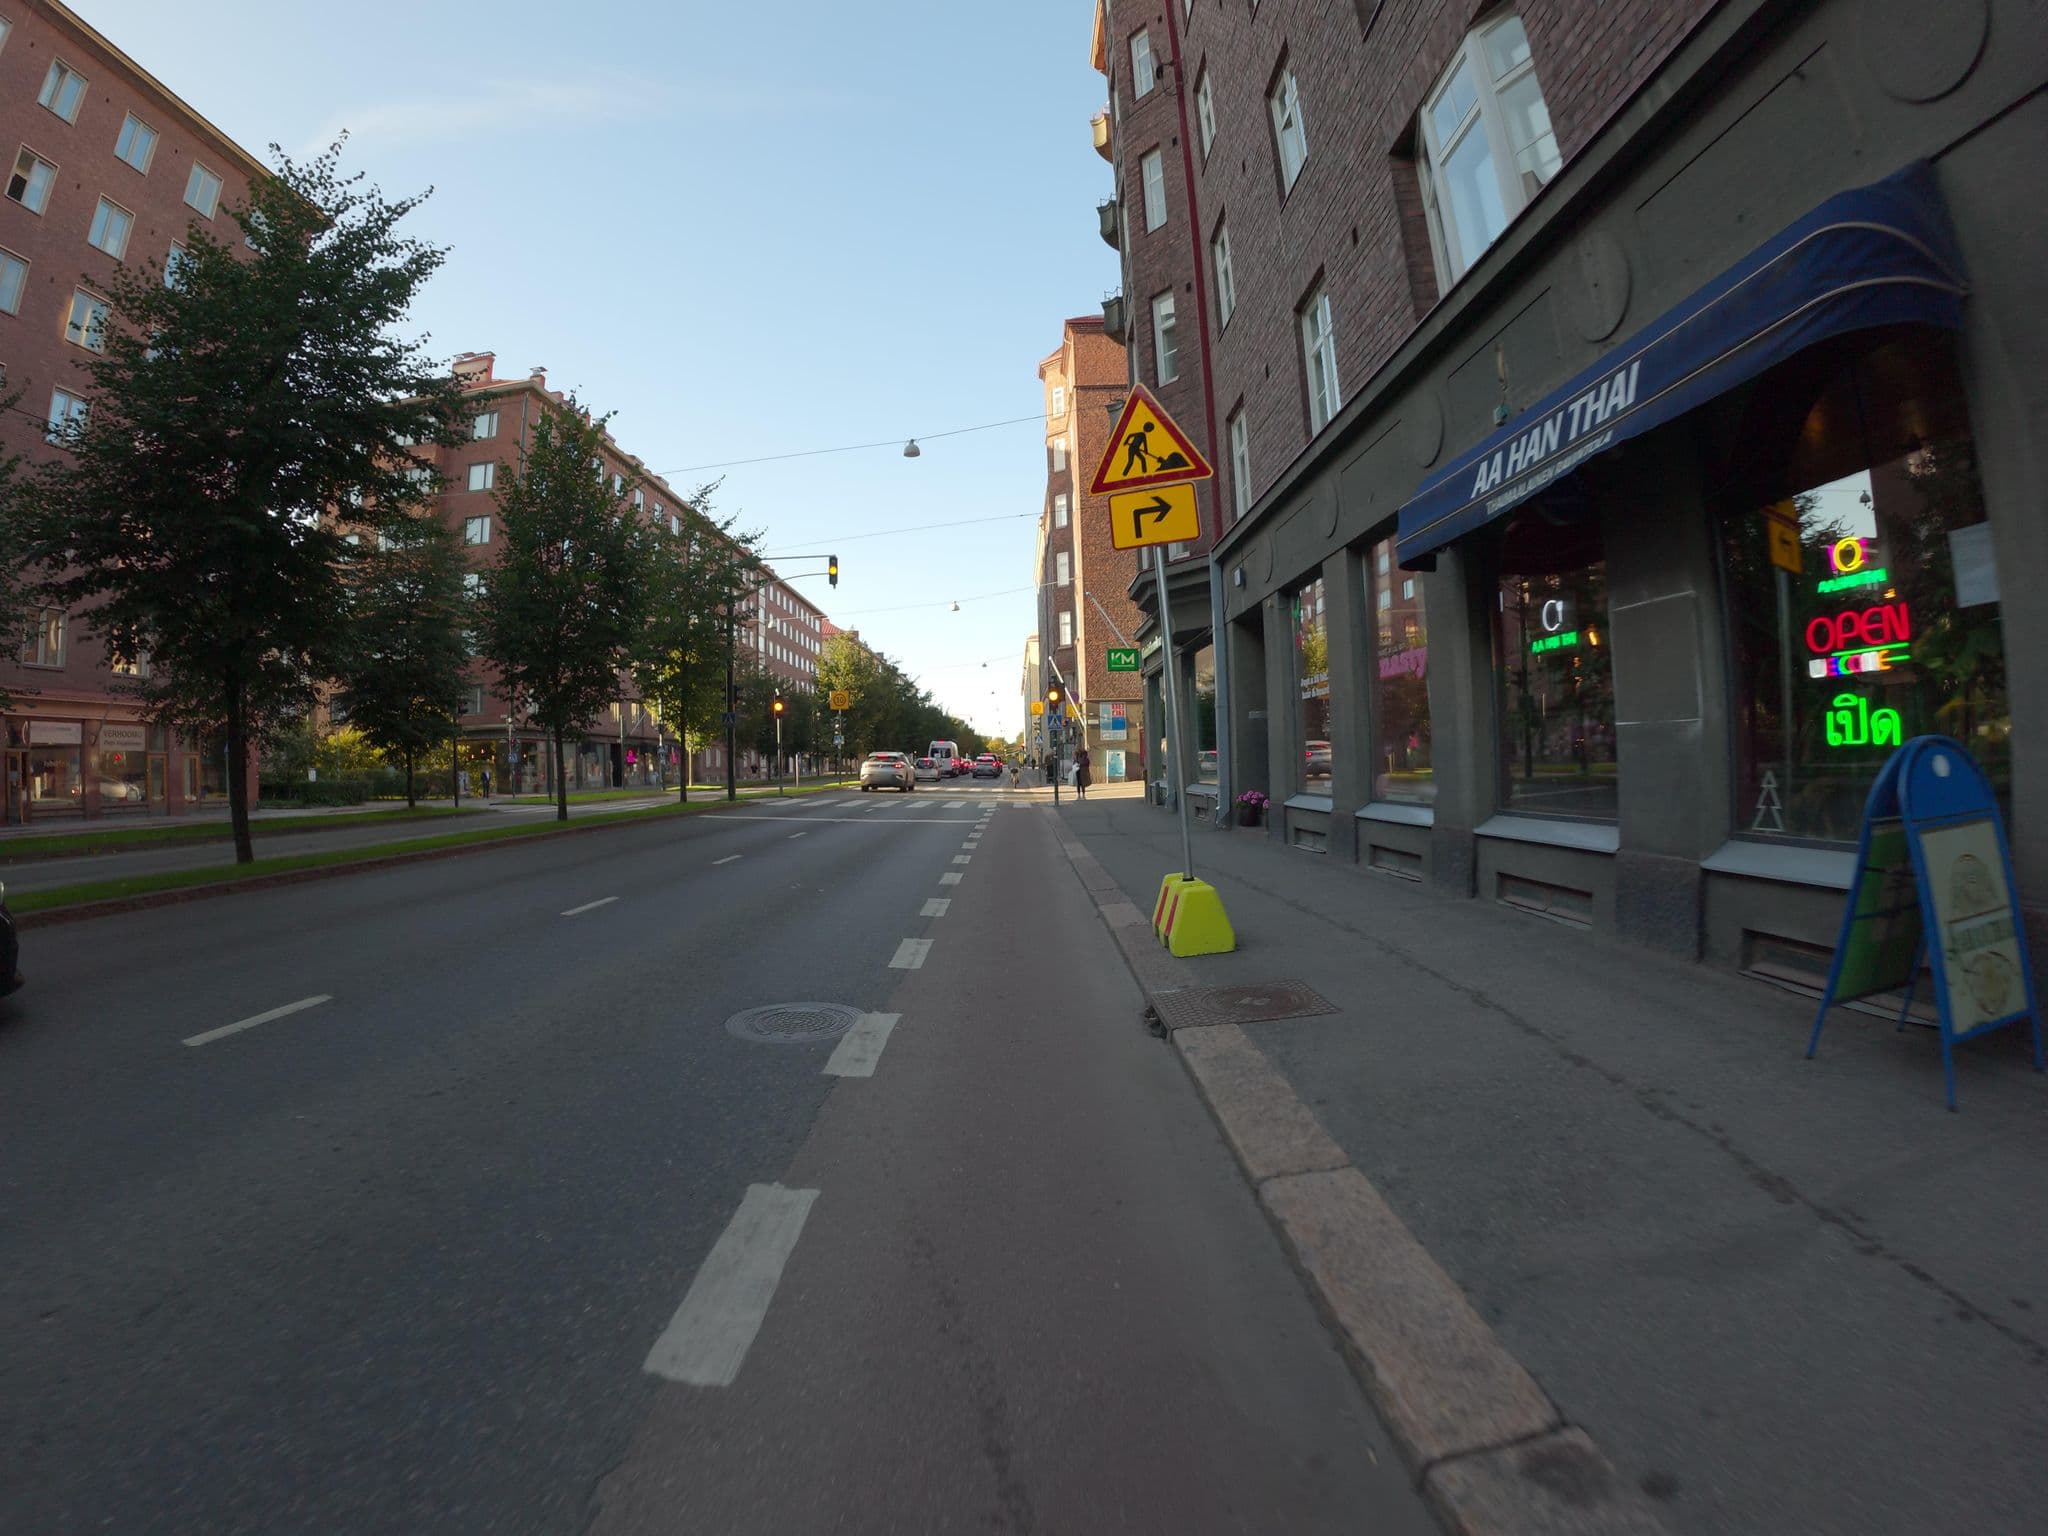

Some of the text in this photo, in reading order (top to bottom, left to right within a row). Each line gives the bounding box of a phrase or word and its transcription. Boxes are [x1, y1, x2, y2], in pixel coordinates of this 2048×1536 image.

[1471, 451, 1503, 498] AA
[1505, 411, 1565, 478] HAN
[1568, 360, 1641, 441] THAI
[1805, 603, 1910, 652] OPEN
[1826, 694, 1901, 746] เปิด
